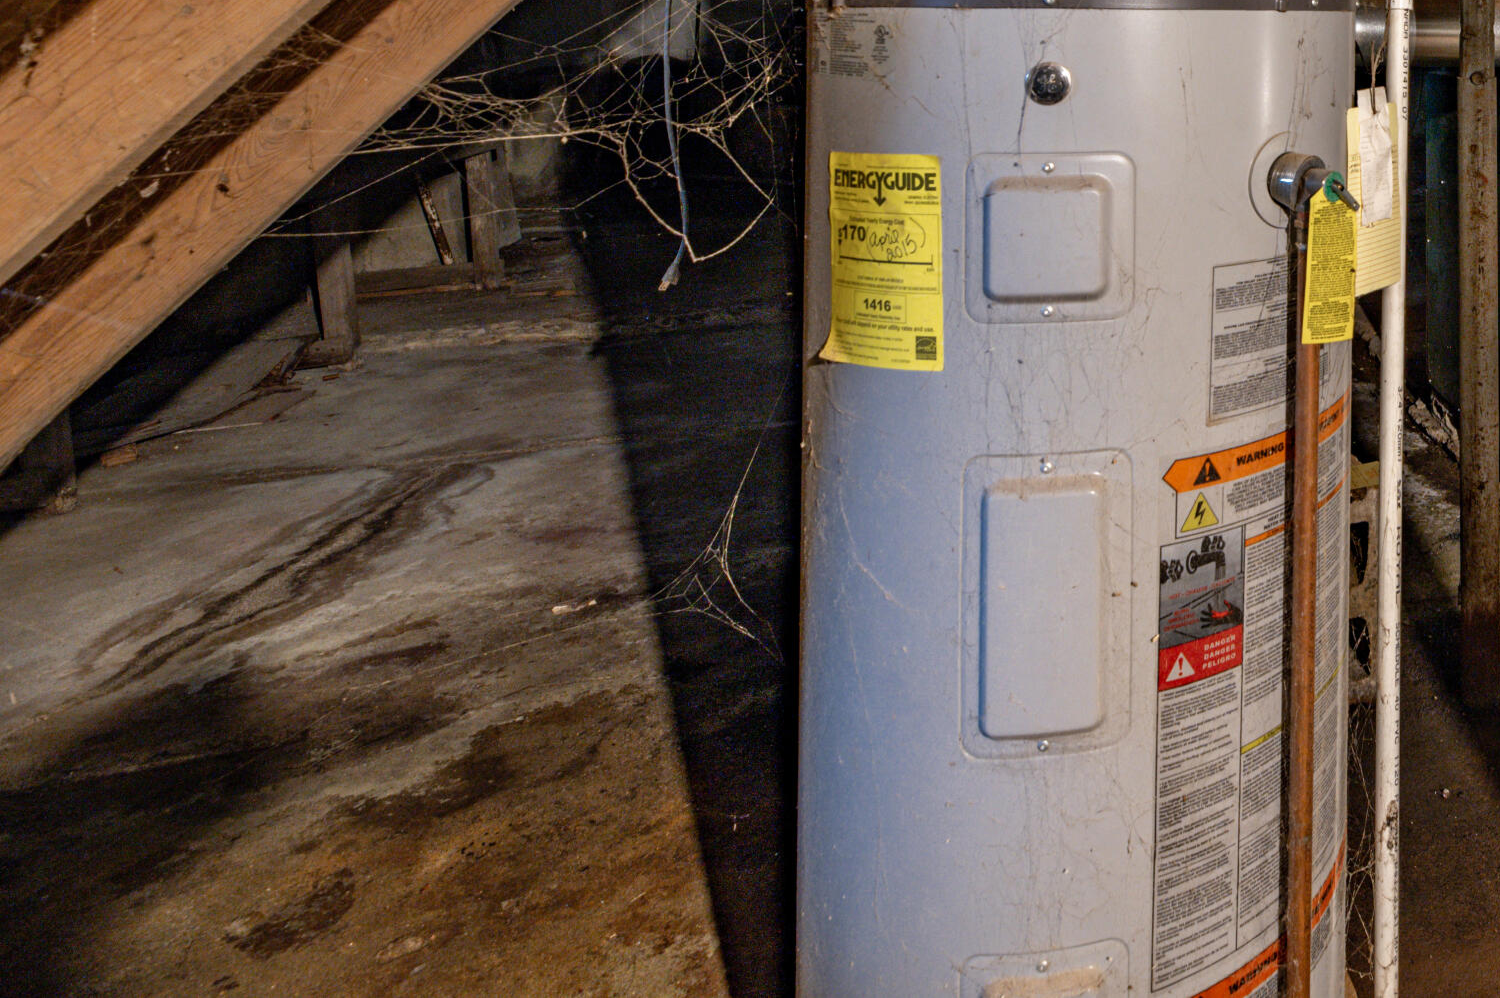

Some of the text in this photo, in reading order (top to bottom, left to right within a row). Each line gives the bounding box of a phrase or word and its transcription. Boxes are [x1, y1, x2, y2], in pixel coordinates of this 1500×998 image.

[834, 168, 937, 192] ENERGYGUIDE
[863, 297, 892, 313] 1416
[1236, 441, 1285, 467] WARNING
[1204, 634, 1237, 651] DANGER
[1202, 652, 1237, 670] PELIGRO
[1203, 643, 1237, 661] DANGER
